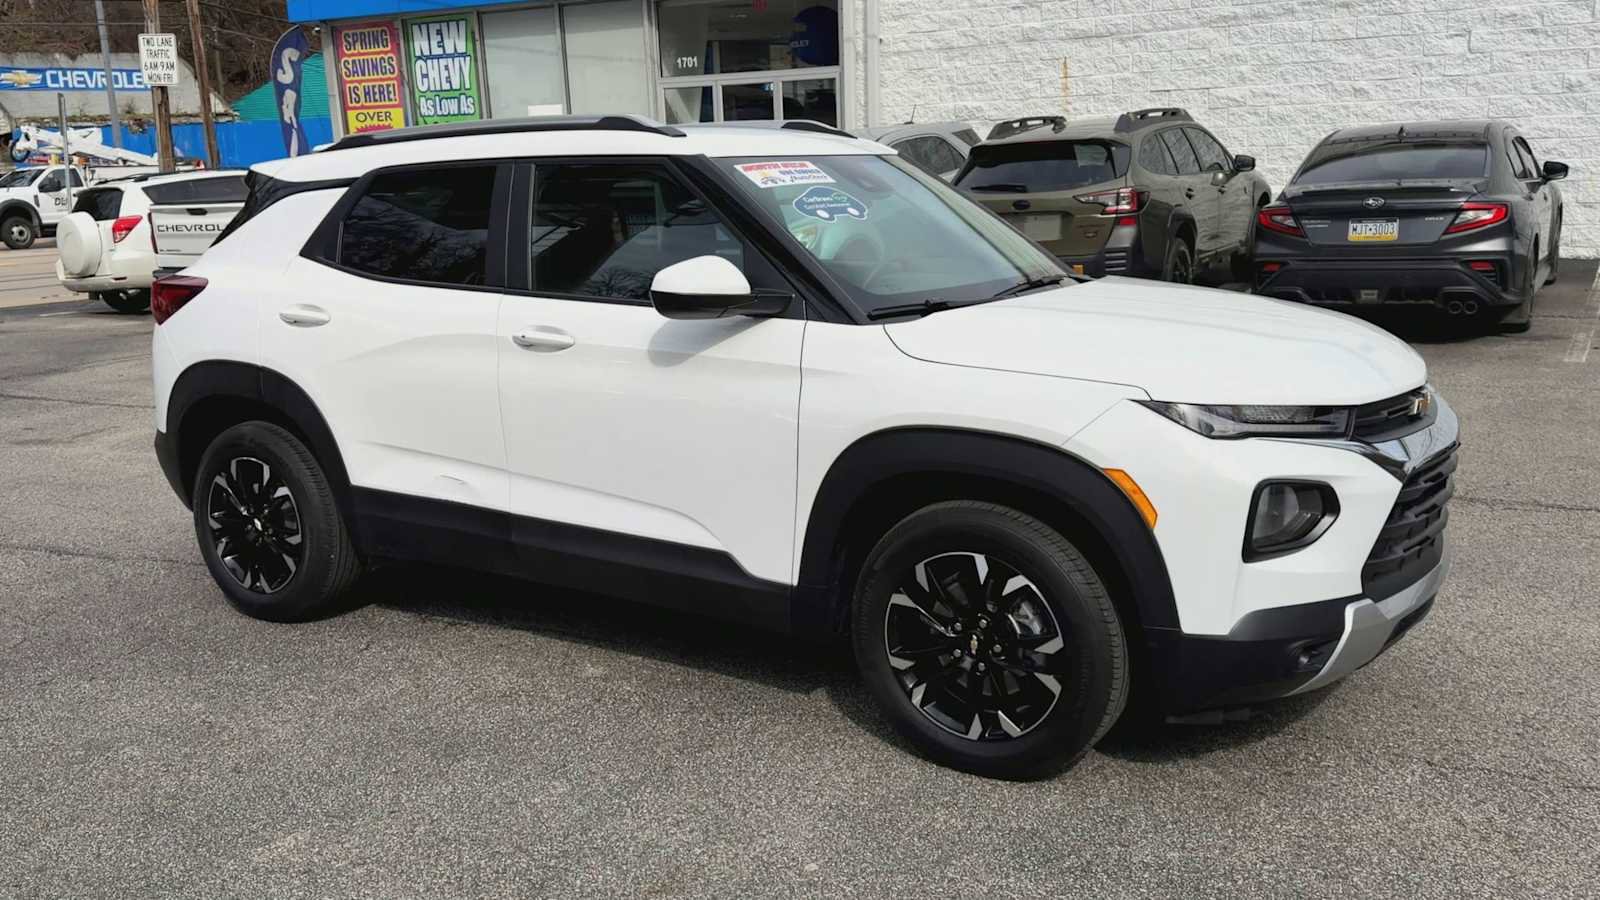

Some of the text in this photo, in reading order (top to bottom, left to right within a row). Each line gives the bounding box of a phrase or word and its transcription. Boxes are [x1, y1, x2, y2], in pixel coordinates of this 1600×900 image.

[141, 37, 173, 47] TWO LANE
[343, 29, 389, 51] SPRING
[412, 21, 467, 56] NEW
[145, 48, 170, 59] TRAFFIC
[676, 55, 698, 69] 1701
[342, 56, 396, 78] SAVINGS
[414, 56, 471, 92] CHEVY
[46, 70, 152, 89] CHEVROLE
[348, 83, 397, 104] IS HERE!
[355, 111, 393, 123] OVER
